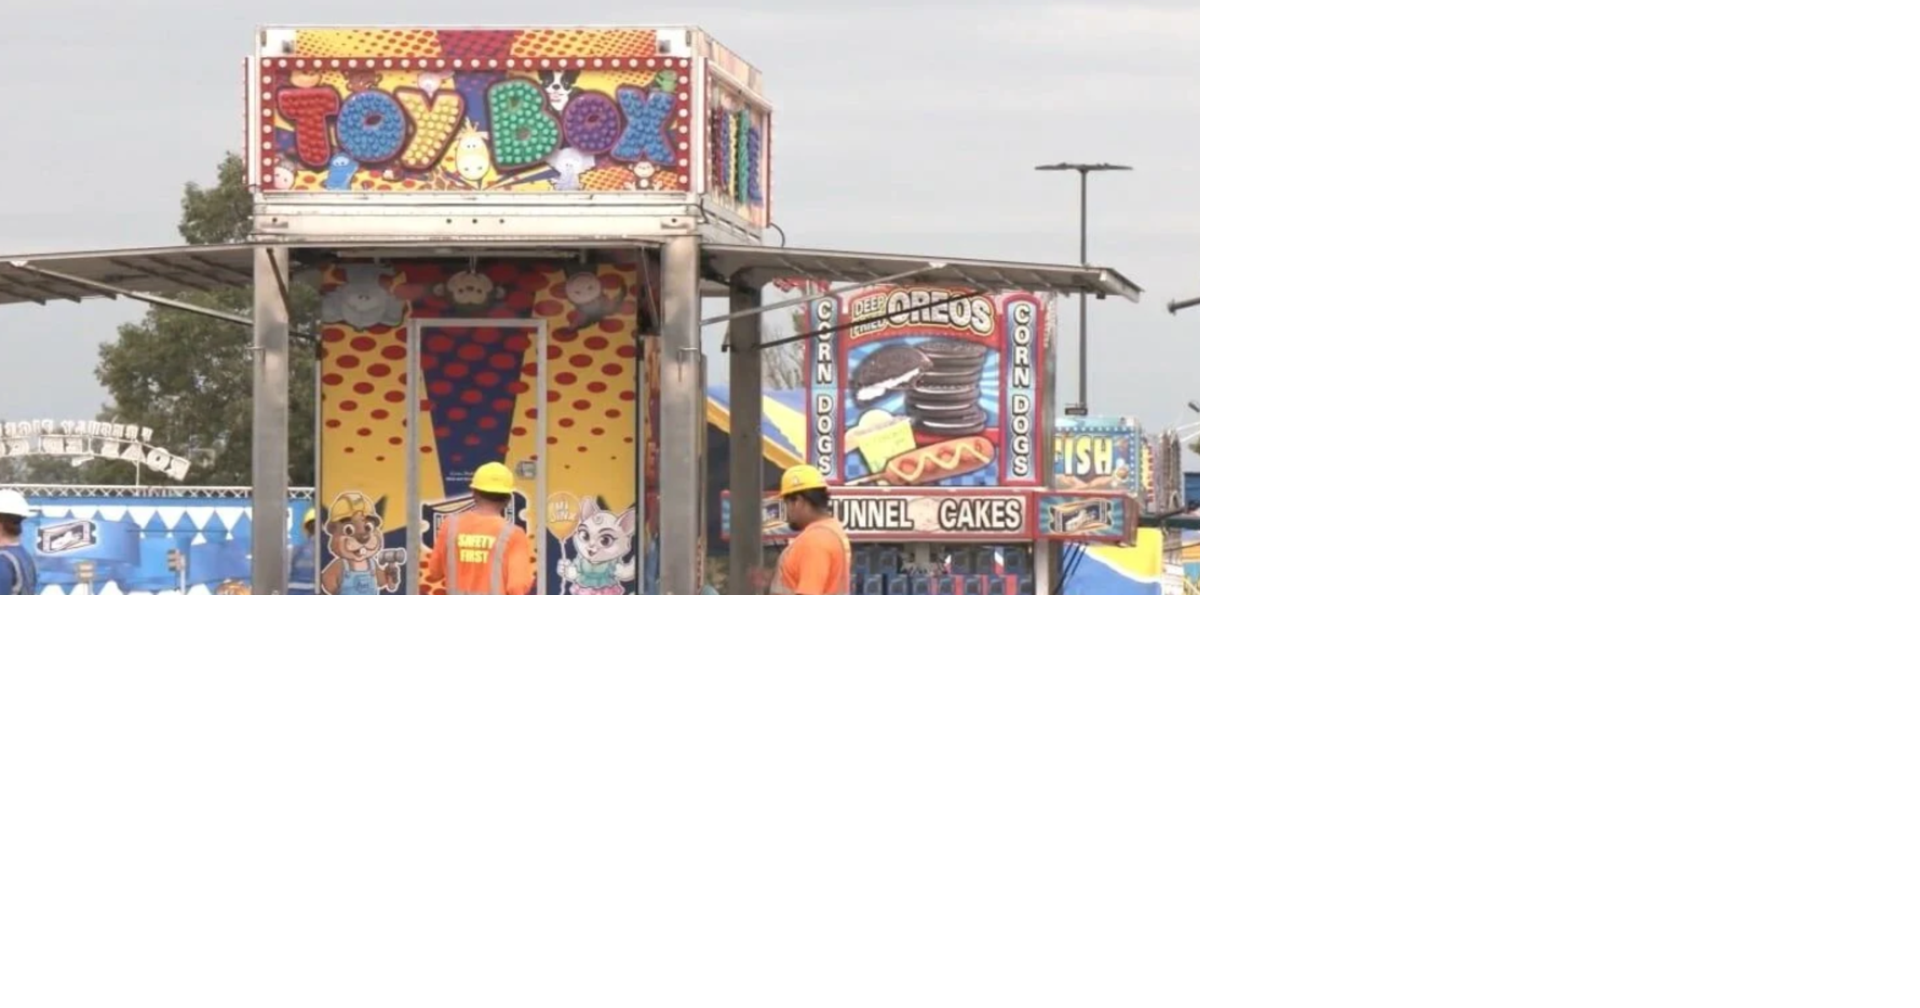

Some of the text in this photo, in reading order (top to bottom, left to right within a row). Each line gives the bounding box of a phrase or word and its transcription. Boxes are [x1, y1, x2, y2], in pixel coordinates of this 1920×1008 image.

[275, 86, 465, 170] TOY
[487, 78, 680, 168] BOX
[853, 295, 885, 317] DEEP
[887, 289, 993, 333] OREOS
[815, 299, 834, 477] CORN DOGS
[1010, 303, 1032, 476] CORN DOGS
[827, 499, 1023, 530] UNNEL CAKES
[457, 533, 495, 549] SAFETY
[459, 549, 489, 563] FIRST
